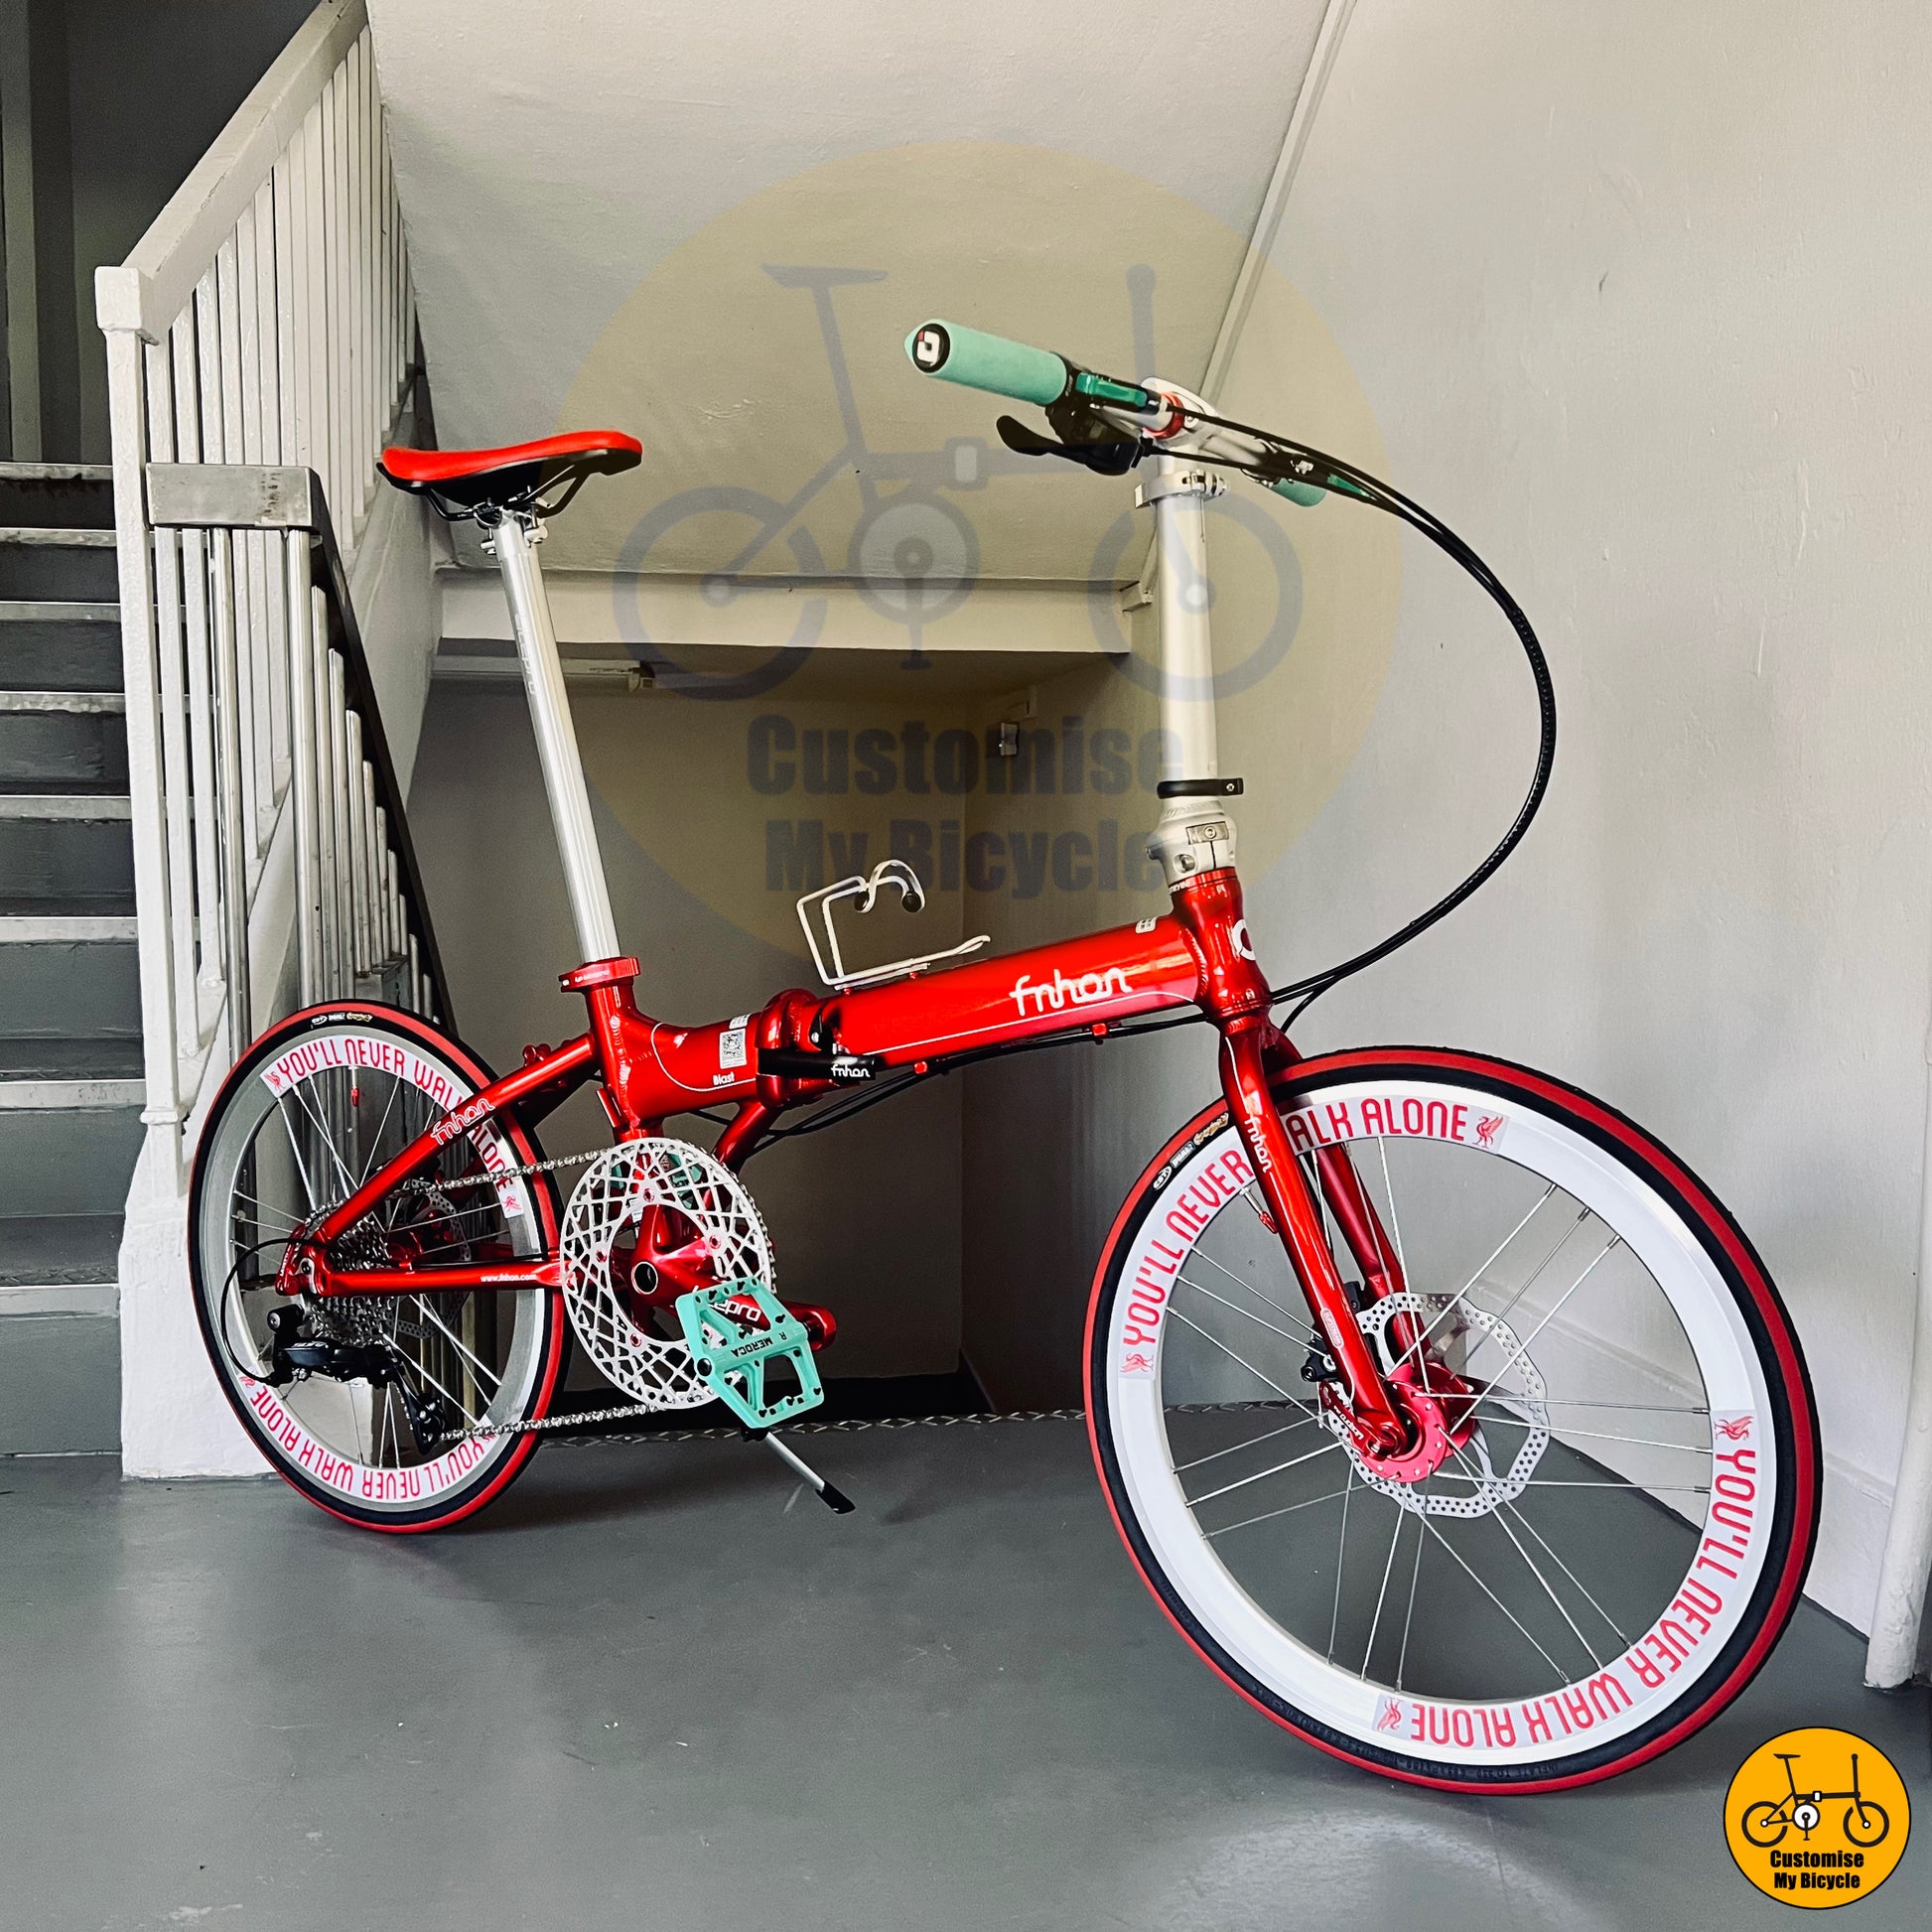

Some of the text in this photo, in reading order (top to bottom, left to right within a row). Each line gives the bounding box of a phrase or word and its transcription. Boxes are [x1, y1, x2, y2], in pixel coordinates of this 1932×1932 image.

[1009, 969, 1134, 1017] fnhon
[277, 1038, 343, 1083] YOU'LL
[345, 1038, 406, 1077] NEVER
[413, 1058, 464, 1111] WAL
[712, 1071, 735, 1086] Blast
[830, 1064, 871, 1078] fnhon
[1123, 1239, 1184, 1346] YOU'LL
[1166, 1149, 1255, 1242] NEVER
[1285, 1101, 1354, 1152] ALK
[1360, 1098, 1468, 1142] ALONE
[731, 1336, 773, 1357] MEROCA
[250, 1385, 485, 1500] YOU'LL NEVER WALK ALONE
[1696, 1449, 1756, 1580] YOU'LL
[1624, 1577, 1724, 1689] NEVER
[1410, 1702, 1517, 1748] ALONE
[1521, 1672, 1635, 1745] WALK
